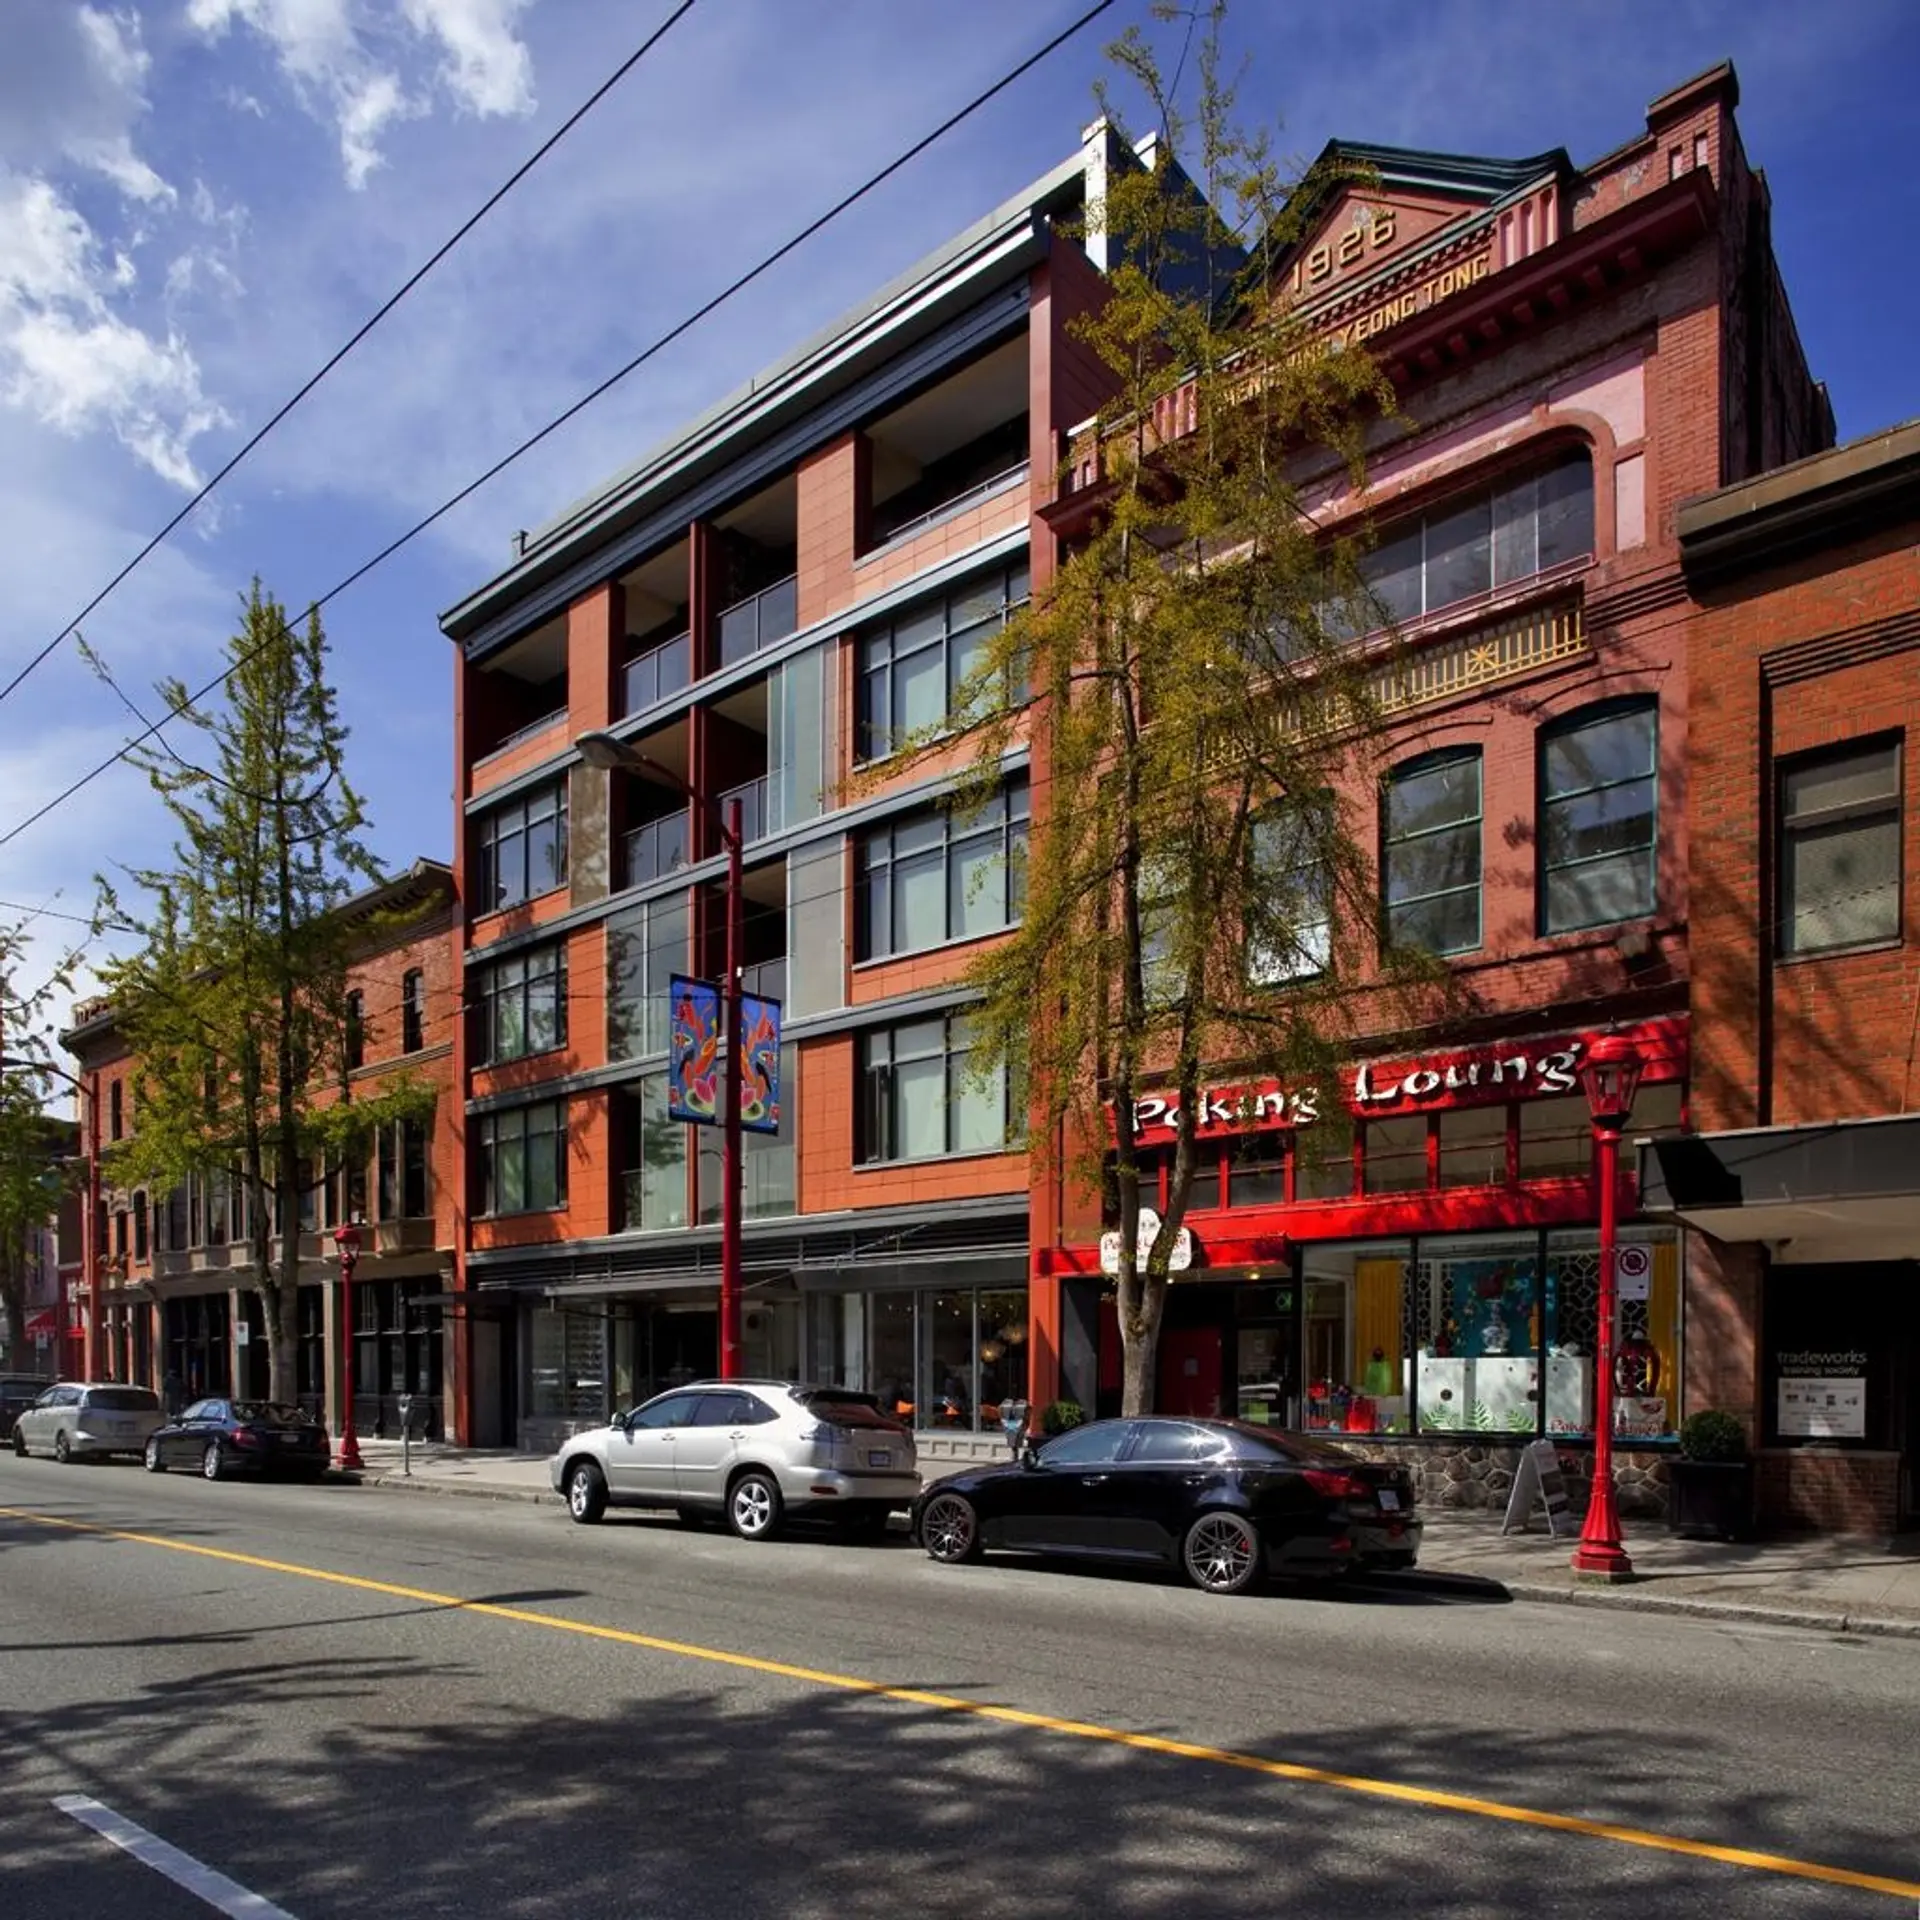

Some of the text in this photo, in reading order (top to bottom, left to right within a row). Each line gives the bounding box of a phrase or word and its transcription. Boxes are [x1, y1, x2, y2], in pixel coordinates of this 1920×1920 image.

[1293, 210, 1396, 292] 1926
[1423, 253, 1490, 304] TONG
[1776, 1350, 1868, 1365] tradeworks
